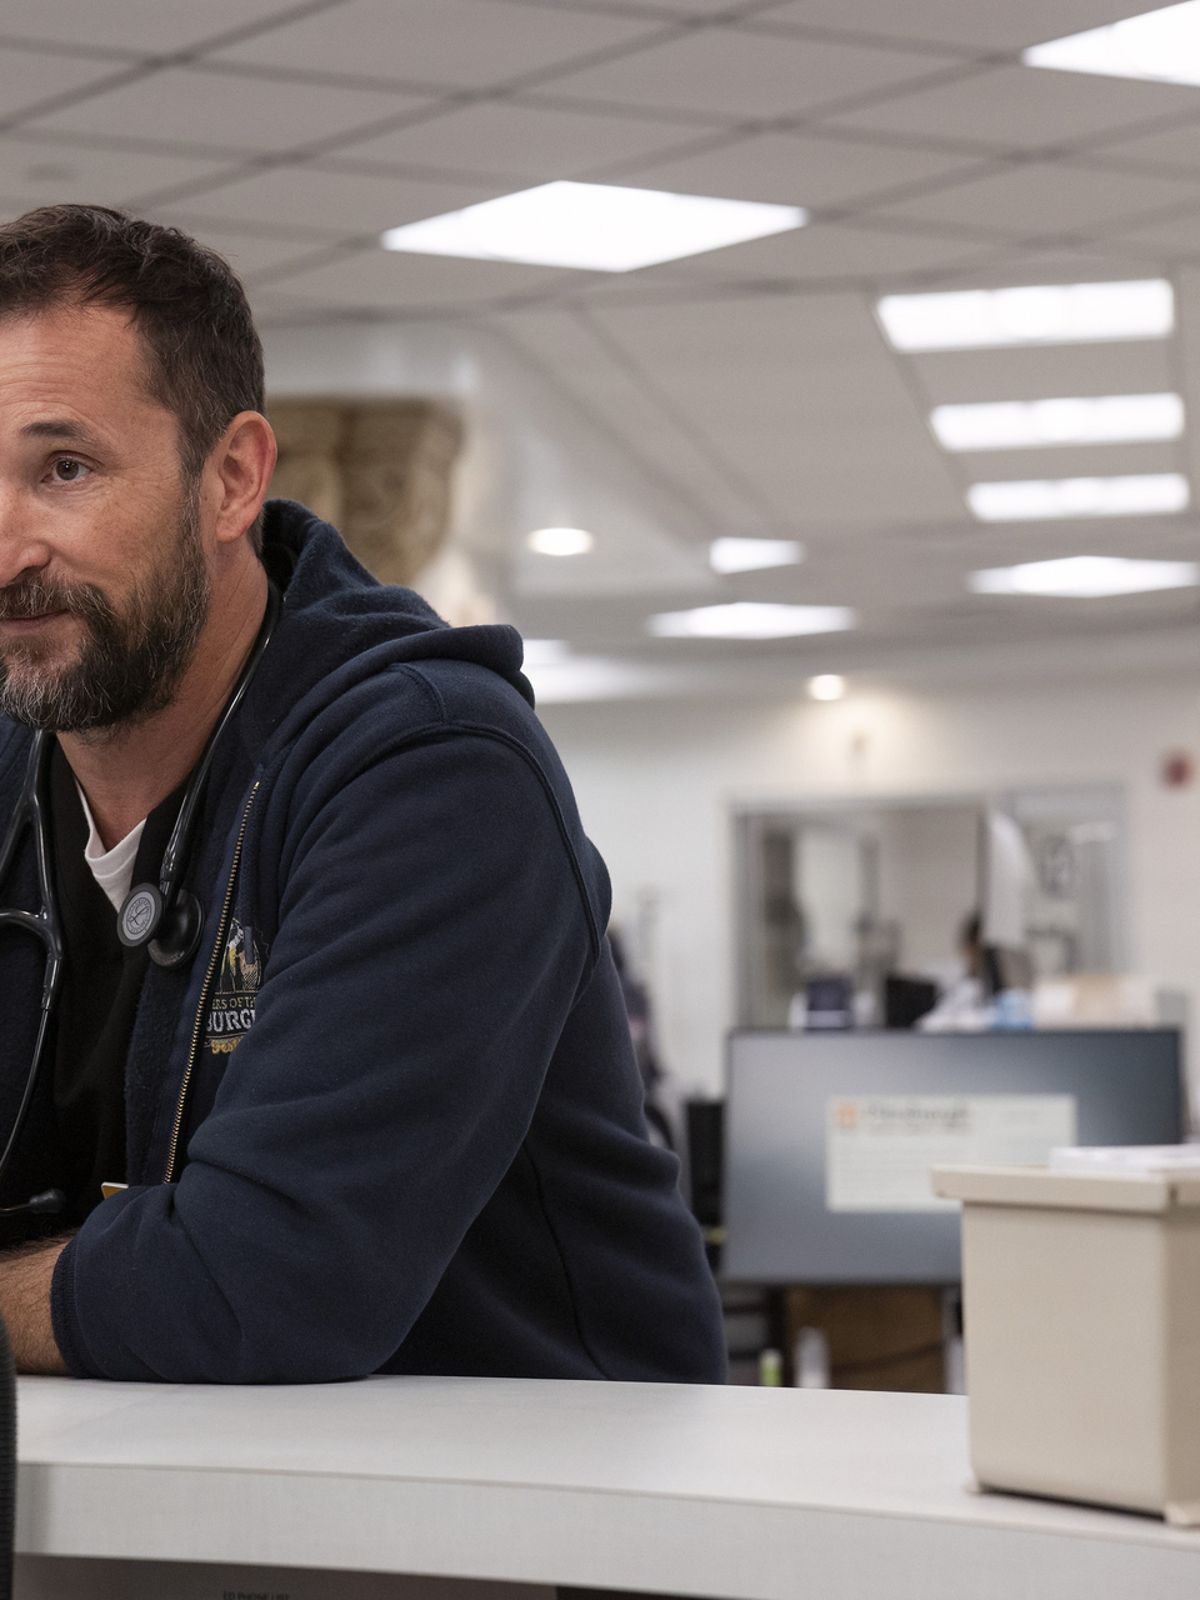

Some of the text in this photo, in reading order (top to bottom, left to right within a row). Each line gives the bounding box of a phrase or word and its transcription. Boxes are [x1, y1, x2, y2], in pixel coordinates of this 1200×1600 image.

[212, 999, 227, 1010] ERS
[245, 996, 255, 1008] TH
[207, 1009, 256, 1032] URG
